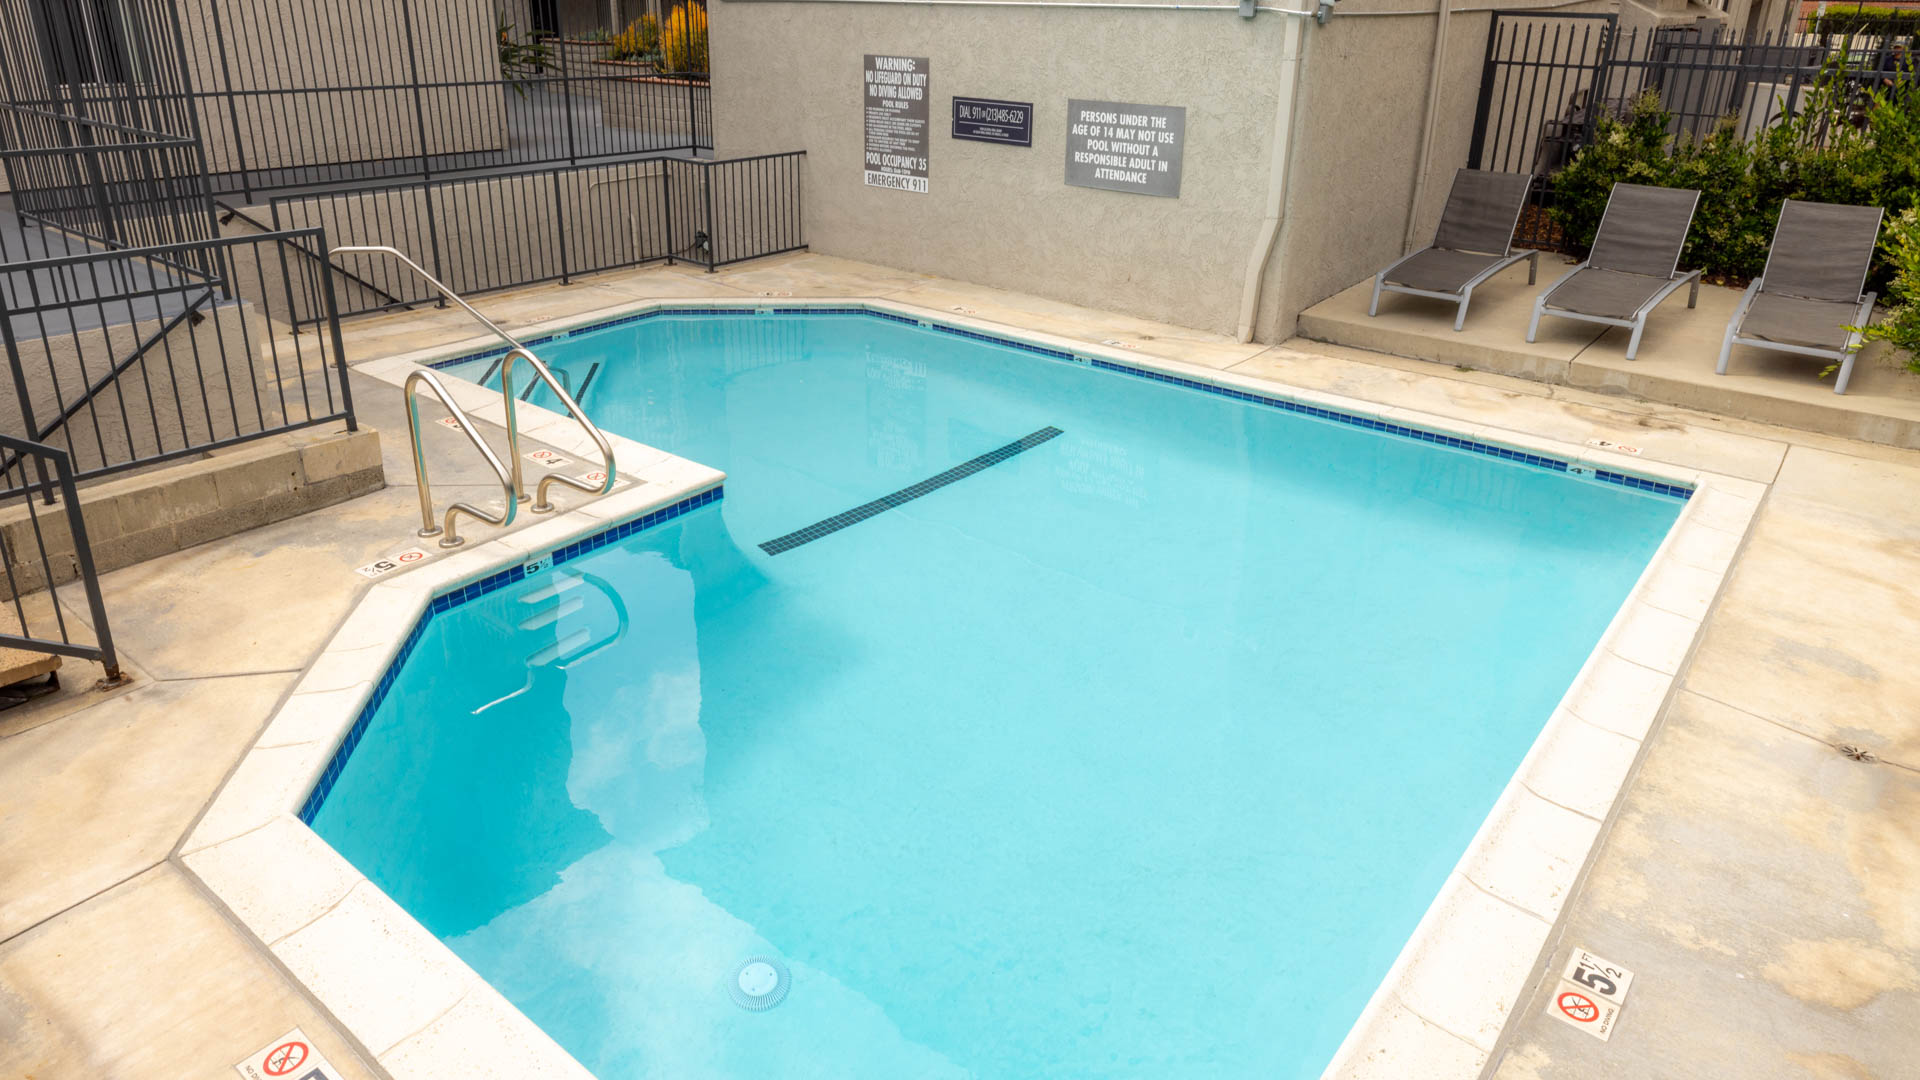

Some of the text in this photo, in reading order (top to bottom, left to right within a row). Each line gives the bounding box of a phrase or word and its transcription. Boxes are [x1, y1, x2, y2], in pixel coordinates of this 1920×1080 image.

[875, 56, 916, 72] WARNING:
[865, 70, 927, 87] NO LIFEGUARD ON DUTY
[869, 84, 923, 101] NO DIVING ALLOWED
[882, 99, 909, 110] POOL RULES
[959, 104, 971, 119] DIAL
[971, 106, 981, 119] 911
[1081, 110, 1167, 129] PERSONS UNDER THE
[1072, 124, 1175, 144] AGE OF 14 MAY NOT USE
[1087, 139, 1159, 157] POOL WITHOUT A
[865, 151, 881, 165] POOL
[882, 153, 918, 170] OCCUPANCY
[918, 157, 927, 171] 35
[1074, 151, 1168, 172] RESPONSIBLE ADULT IN
[867, 172, 926, 193] EMERGENCY 911
[1094, 167, 1147, 184] ATTENDANCE
[1600, 1007, 1615, 1034] NO DIVING
